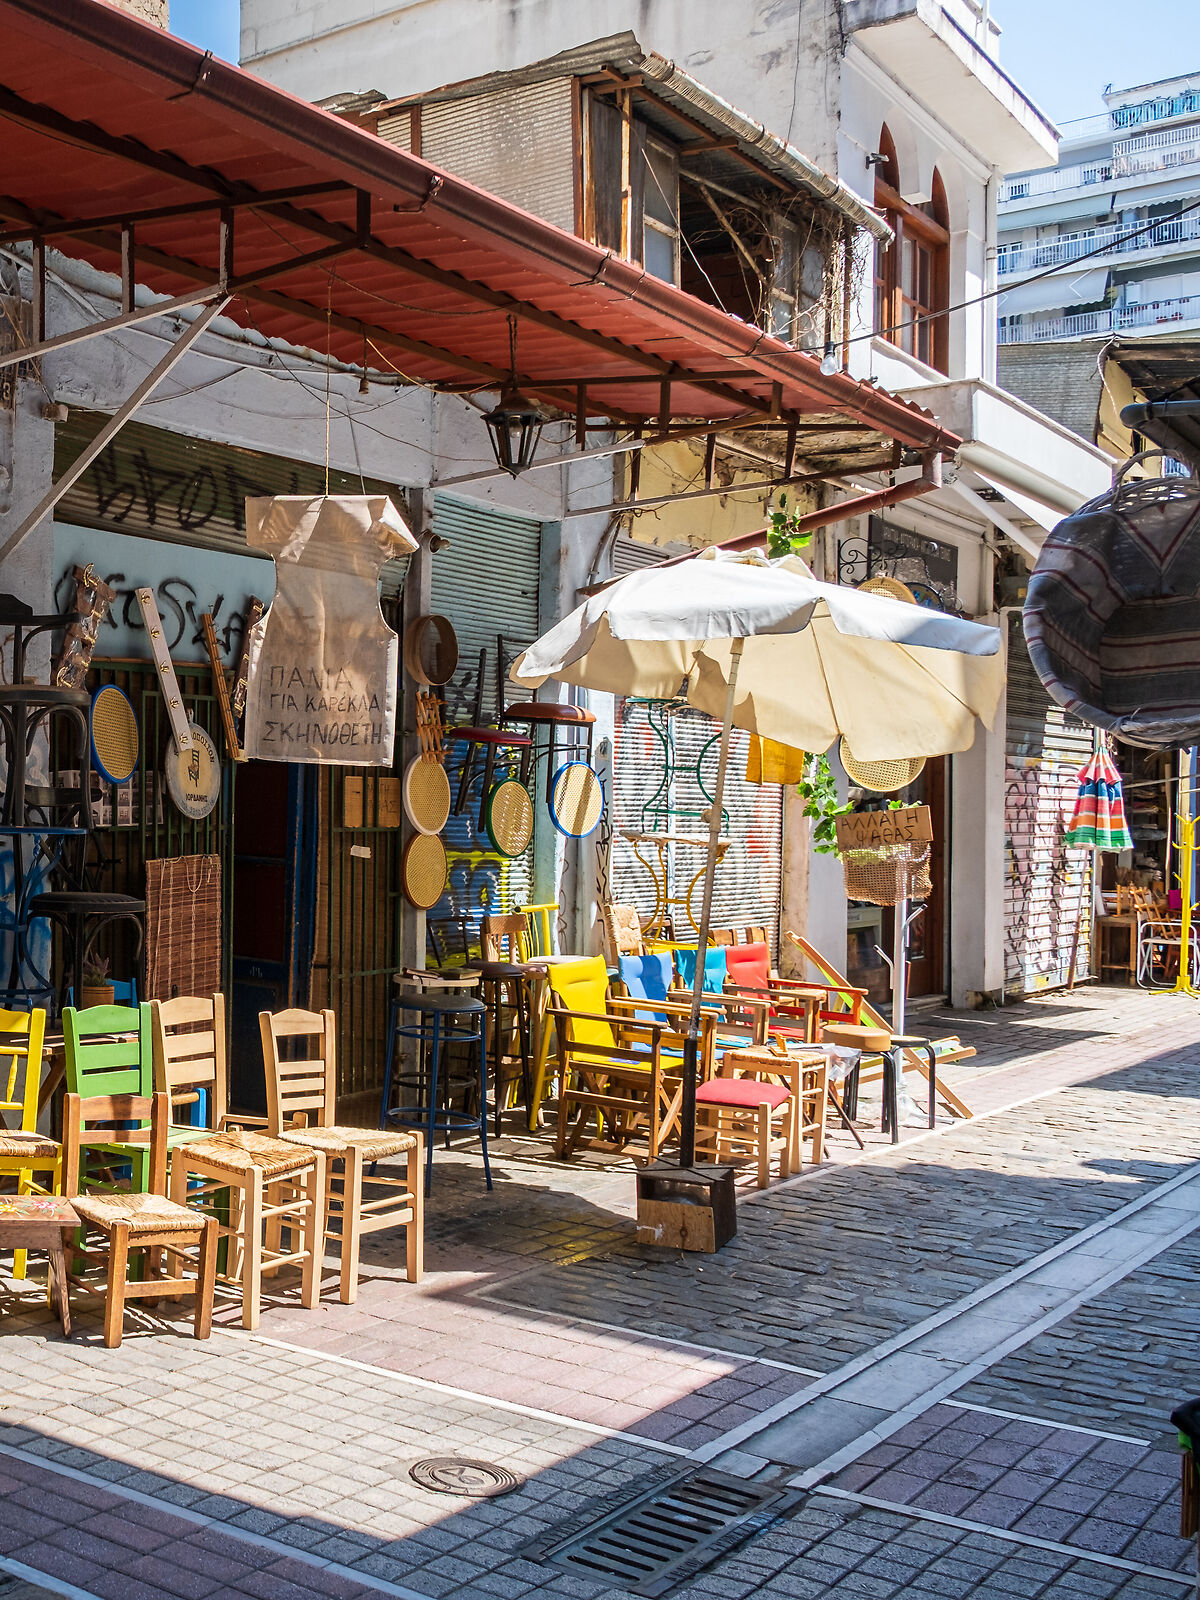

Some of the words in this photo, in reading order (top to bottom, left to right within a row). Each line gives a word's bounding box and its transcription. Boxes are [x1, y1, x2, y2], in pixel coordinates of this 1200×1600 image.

[270, 665, 354, 691] ΠΑΝΙΑ
[270, 693, 299, 712] ΓΙΑ
[841, 809, 919, 830] ΑΛΛΑΓΗ
[856, 825, 920, 845] ΨΑΘΑΣ
